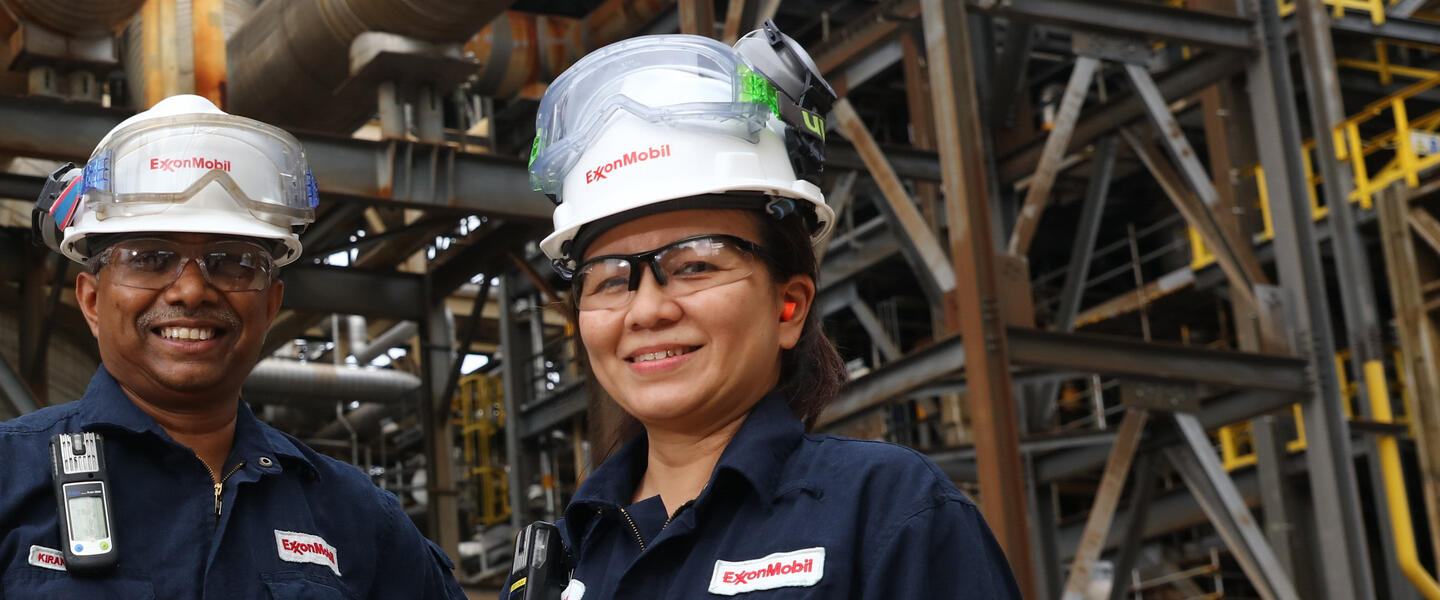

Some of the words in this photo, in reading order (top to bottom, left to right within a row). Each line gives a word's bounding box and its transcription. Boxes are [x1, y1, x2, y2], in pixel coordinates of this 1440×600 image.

[150, 157, 231, 172] ExxonMobil
[585, 144, 671, 184] ExxonMobil
[723, 558, 813, 585] ExxonMobil
